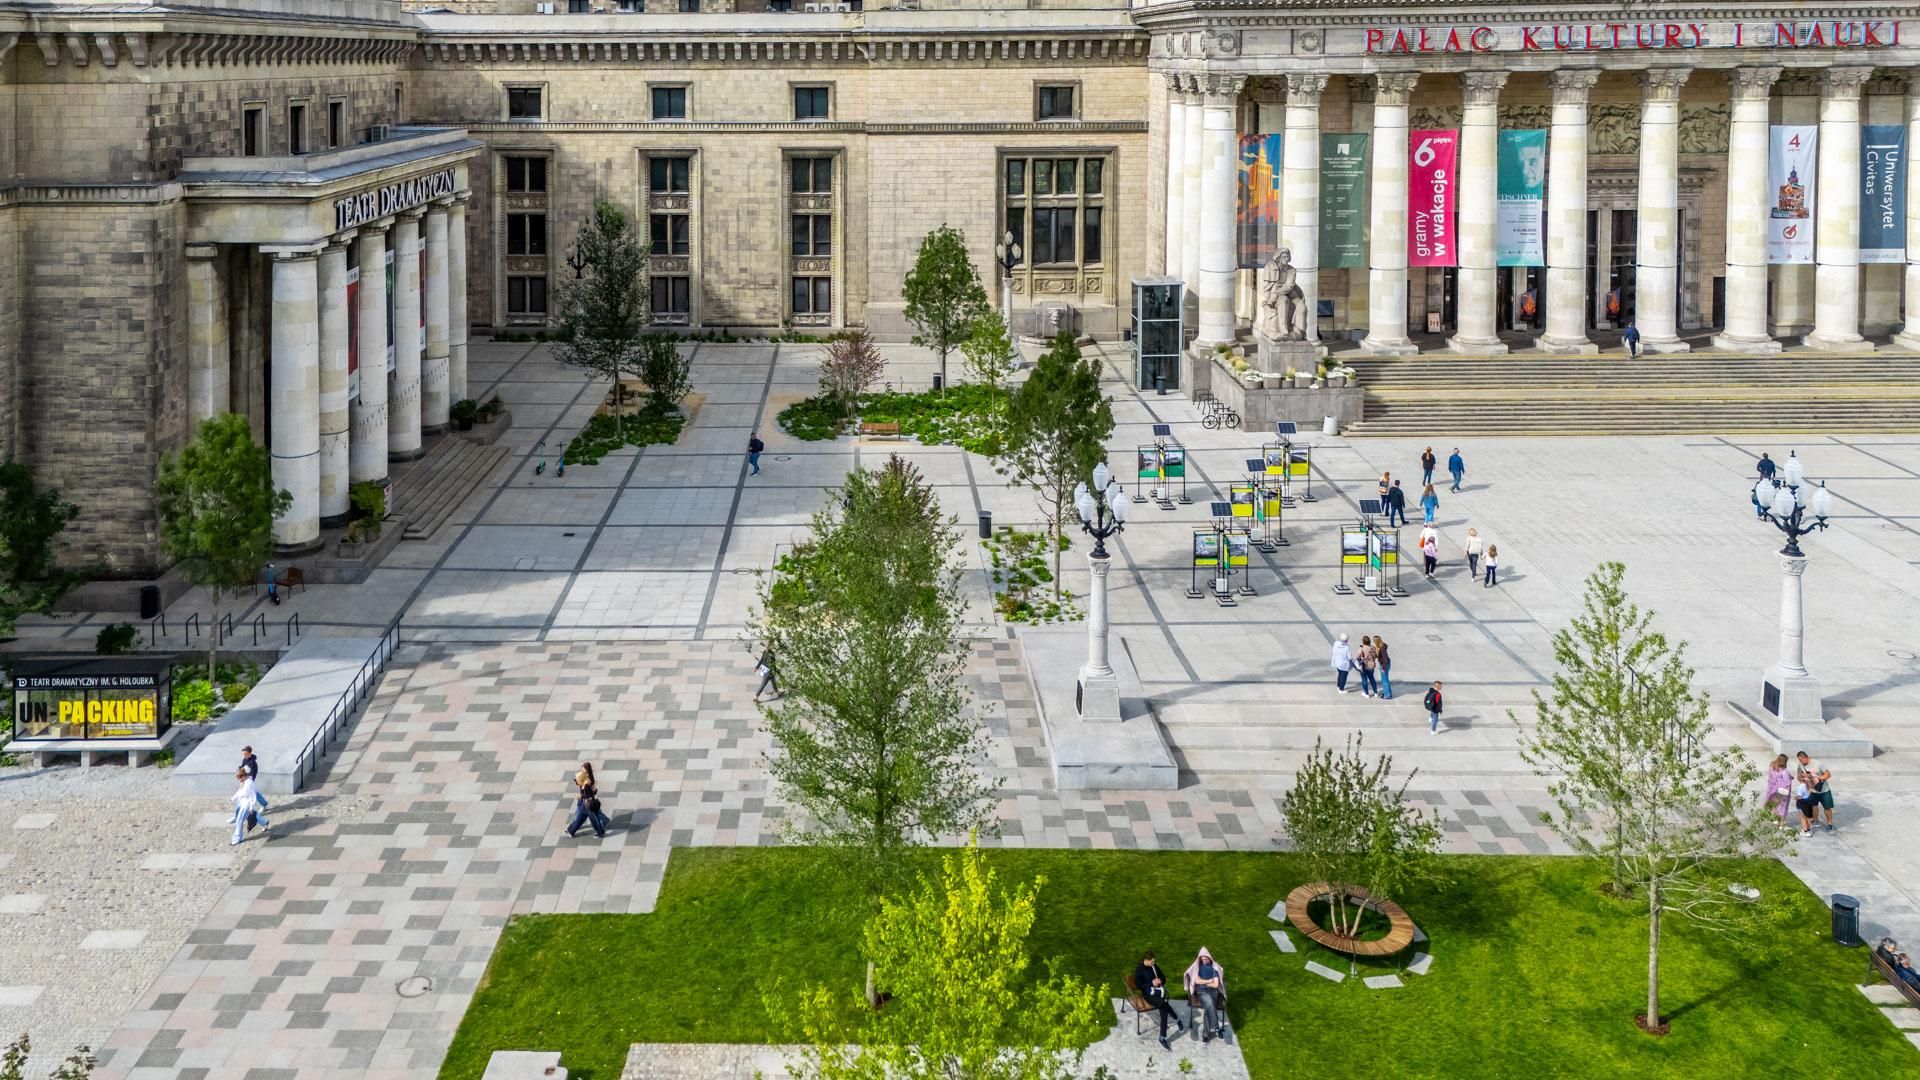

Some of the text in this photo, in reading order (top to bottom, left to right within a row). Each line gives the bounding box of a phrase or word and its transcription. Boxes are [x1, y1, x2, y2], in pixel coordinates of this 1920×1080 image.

[1364, 20, 1902, 53] PAŁAC KULTURY I NAUKI
[1414, 138, 1436, 167] 6
[1788, 133, 1801, 147] 4
[1865, 151, 1879, 195] Civitas
[1880, 151, 1899, 229] Uniwersytet
[337, 169, 456, 230] TEATR DRAMATYCZNY
[1430, 169, 1449, 257] w wakacje
[1416, 210, 1431, 257] gramy
[30, 678, 51, 687] TEATR
[51, 677, 98, 687] DRAMATYCZNY
[100, 677, 111, 686] IM.
[111, 677, 118, 685] G.
[119, 676, 154, 685] HOLOUBKA
